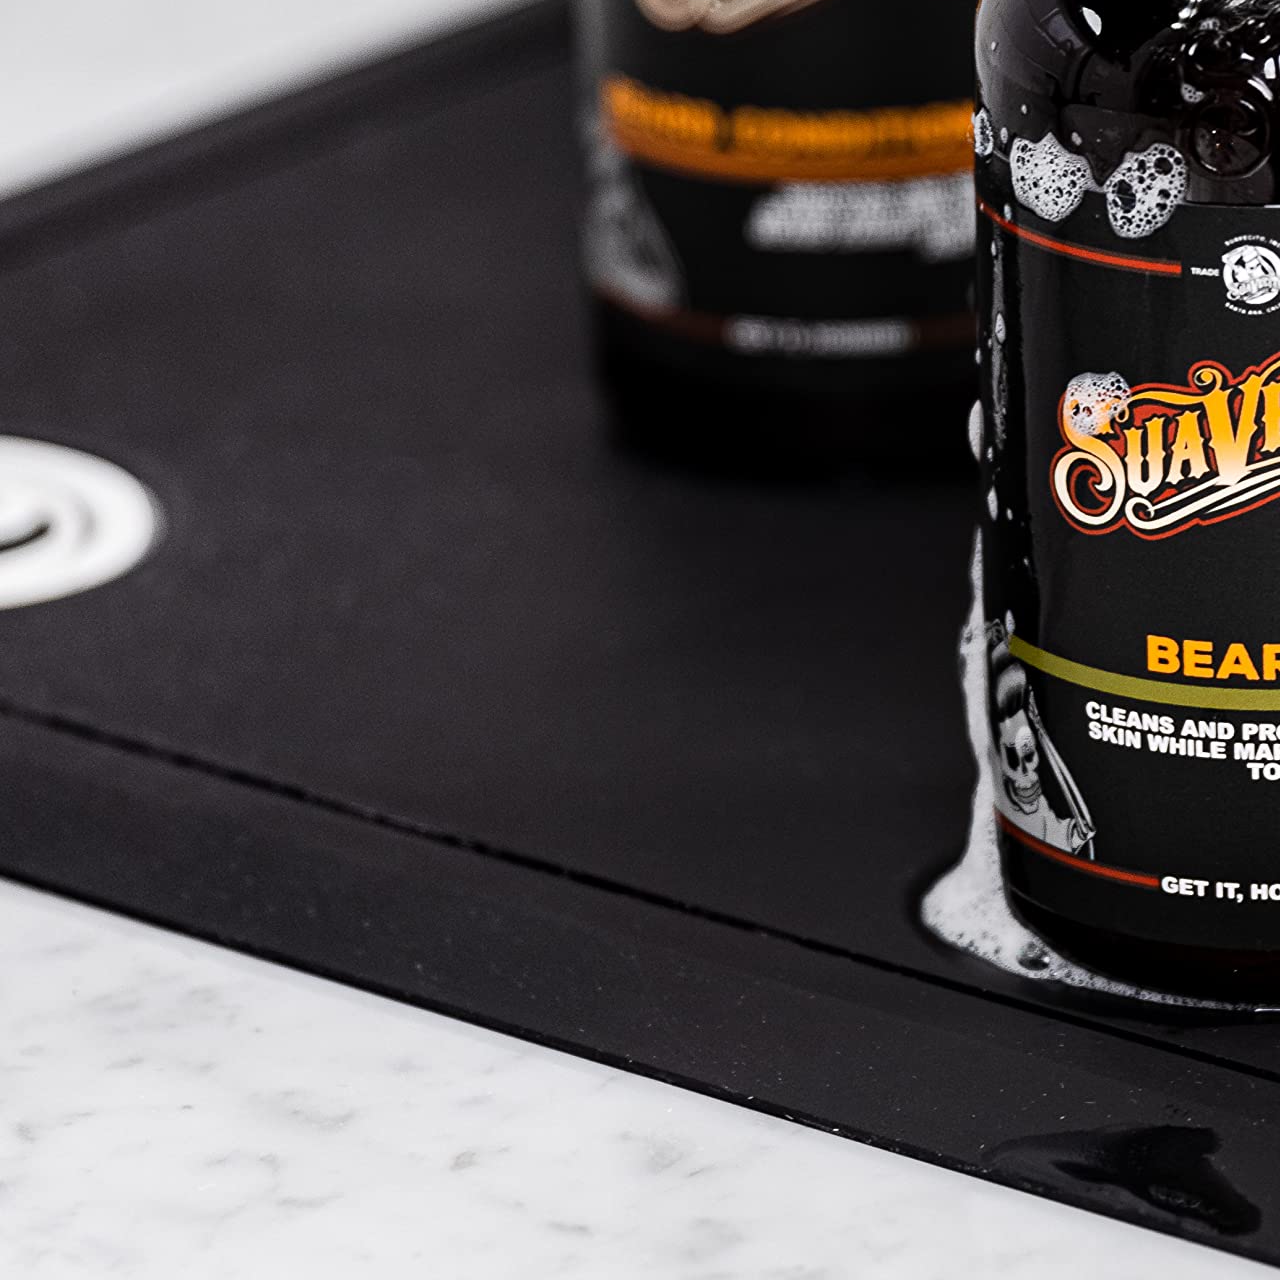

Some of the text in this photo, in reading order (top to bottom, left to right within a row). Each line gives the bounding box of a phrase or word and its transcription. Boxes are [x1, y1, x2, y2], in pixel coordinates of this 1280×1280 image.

[1190, 266, 1220, 277] TRADE
[1086, 701, 1175, 735] CLEANS
[1181, 718, 1234, 740] AND
[1088, 722, 1142, 749] SKIN
[1147, 734, 1226, 760] WHILE
[1161, 876, 1208, 897] GET
[1215, 882, 1243, 903] IT,
